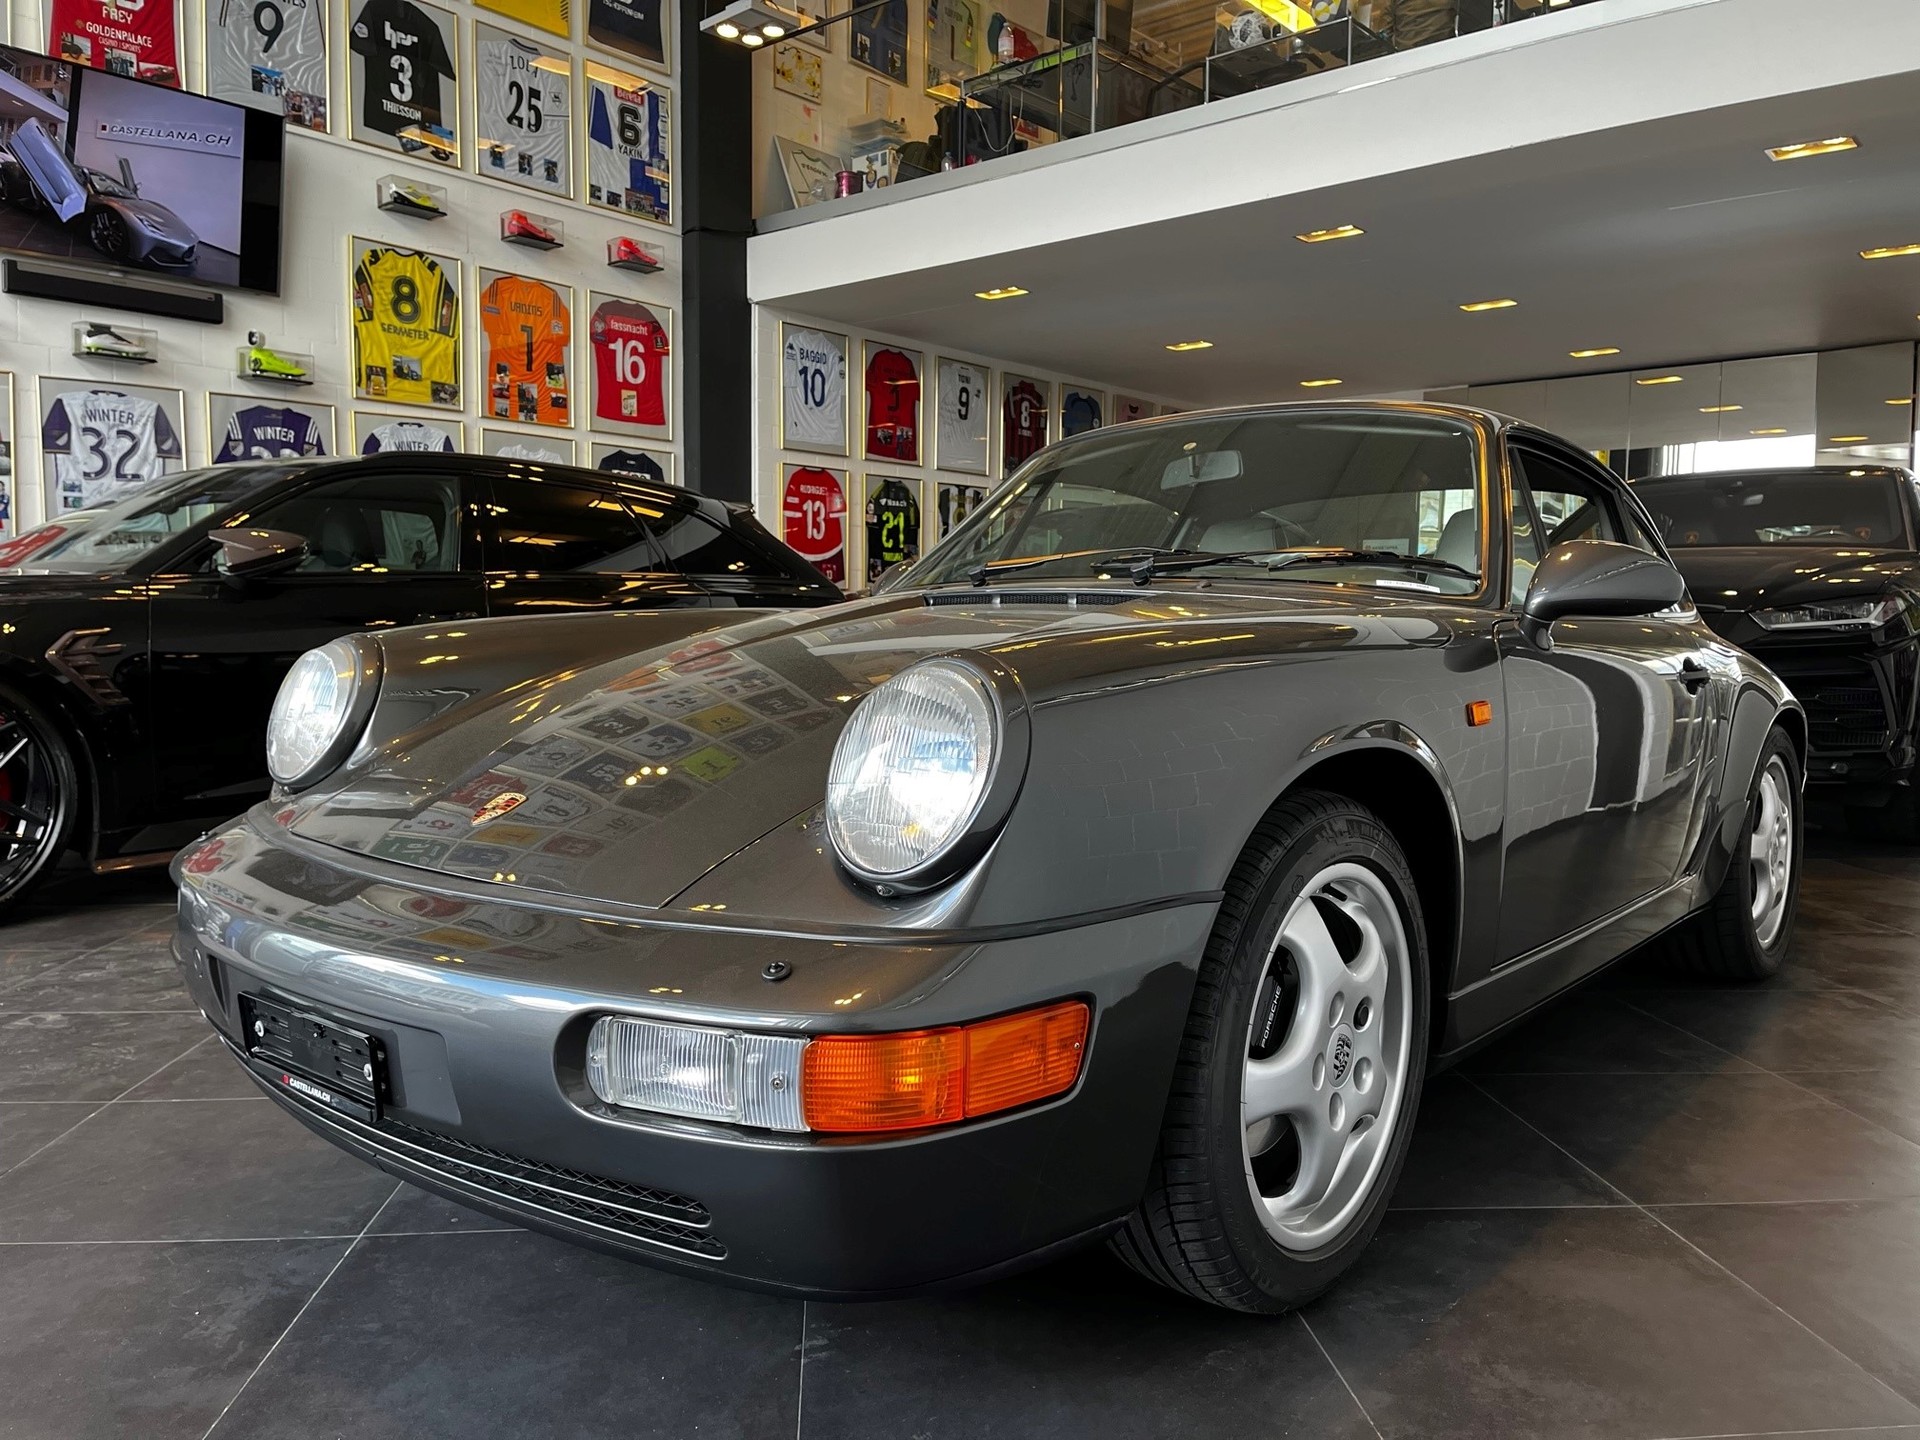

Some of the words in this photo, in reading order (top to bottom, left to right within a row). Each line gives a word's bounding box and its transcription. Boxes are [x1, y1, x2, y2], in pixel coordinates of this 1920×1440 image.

[102, 6, 133, 24] FREY
[254, 1, 284, 53] 9
[86, 21, 152, 48] GOLDENPALACE
[390, 54, 413, 102] 3
[506, 80, 543, 133] 25
[110, 125, 232, 146] CASTELLANA.CH
[618, 103, 641, 148] 6
[618, 143, 643, 160] YAKIN
[390, 274, 421, 325] 8
[381, 323, 430, 341] SERMETER
[520, 324, 534, 372] 1
[608, 337, 646, 385] 16
[799, 347, 828, 365] BAGGIO
[798, 365, 826, 408] 10
[958, 386, 970, 421] 9
[85, 408, 136, 426] WINTER
[1020, 400, 1031, 428] 8
[253, 425, 296, 444] WINTER
[394, 440, 430, 452] WINTER
[82, 426, 145, 482] 32
[802, 499, 827, 541] 13
[882, 511, 905, 549] 21
[1261, 985, 1282, 1049] PORSCHE
[290, 1077, 331, 1103] CASTELLANA.CH
